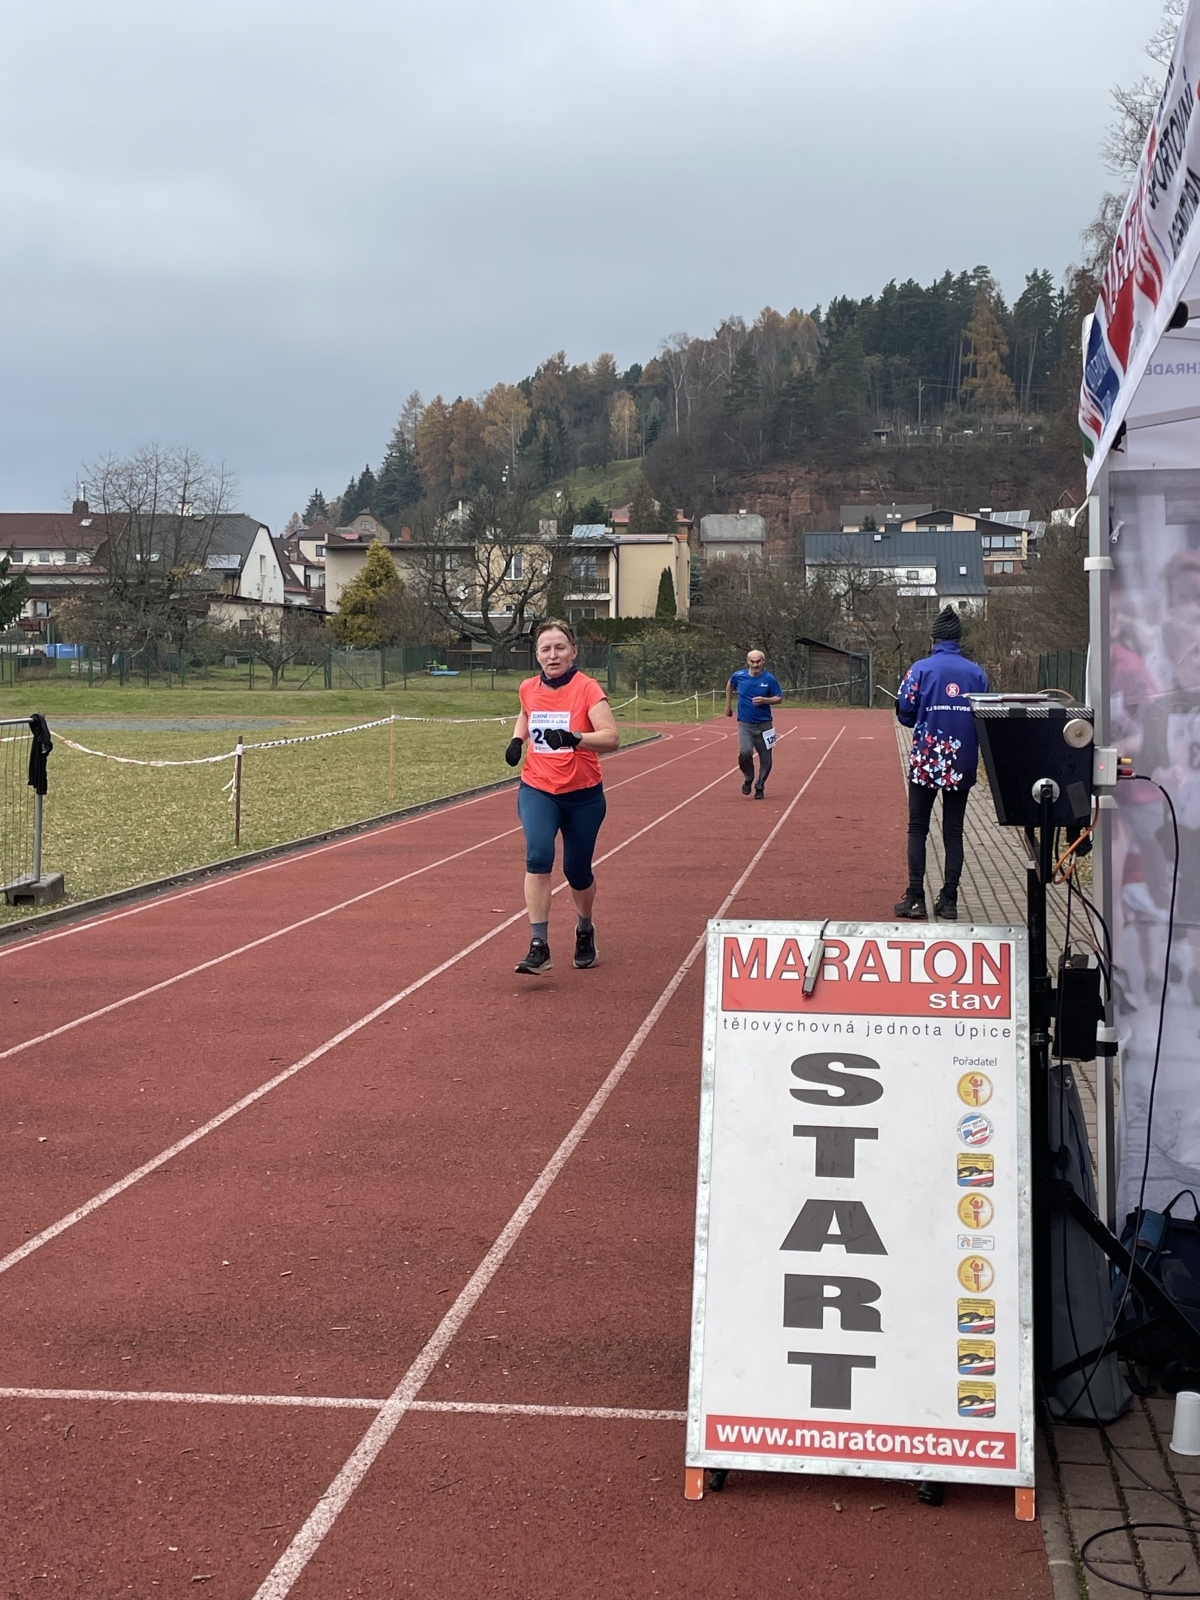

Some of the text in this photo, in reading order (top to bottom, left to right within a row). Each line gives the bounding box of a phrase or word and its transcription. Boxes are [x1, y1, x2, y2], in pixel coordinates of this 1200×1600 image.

[722, 937, 1010, 985] MARATON
[928, 990, 1002, 1011] stav
[722, 1017, 1012, 1040] tělovýchovná jednota Úpice
[953, 1056, 998, 1068] Pořadatel
[779, 1052, 889, 1410] START
[716, 1423, 1006, 1460] www.maratonstav.cz
